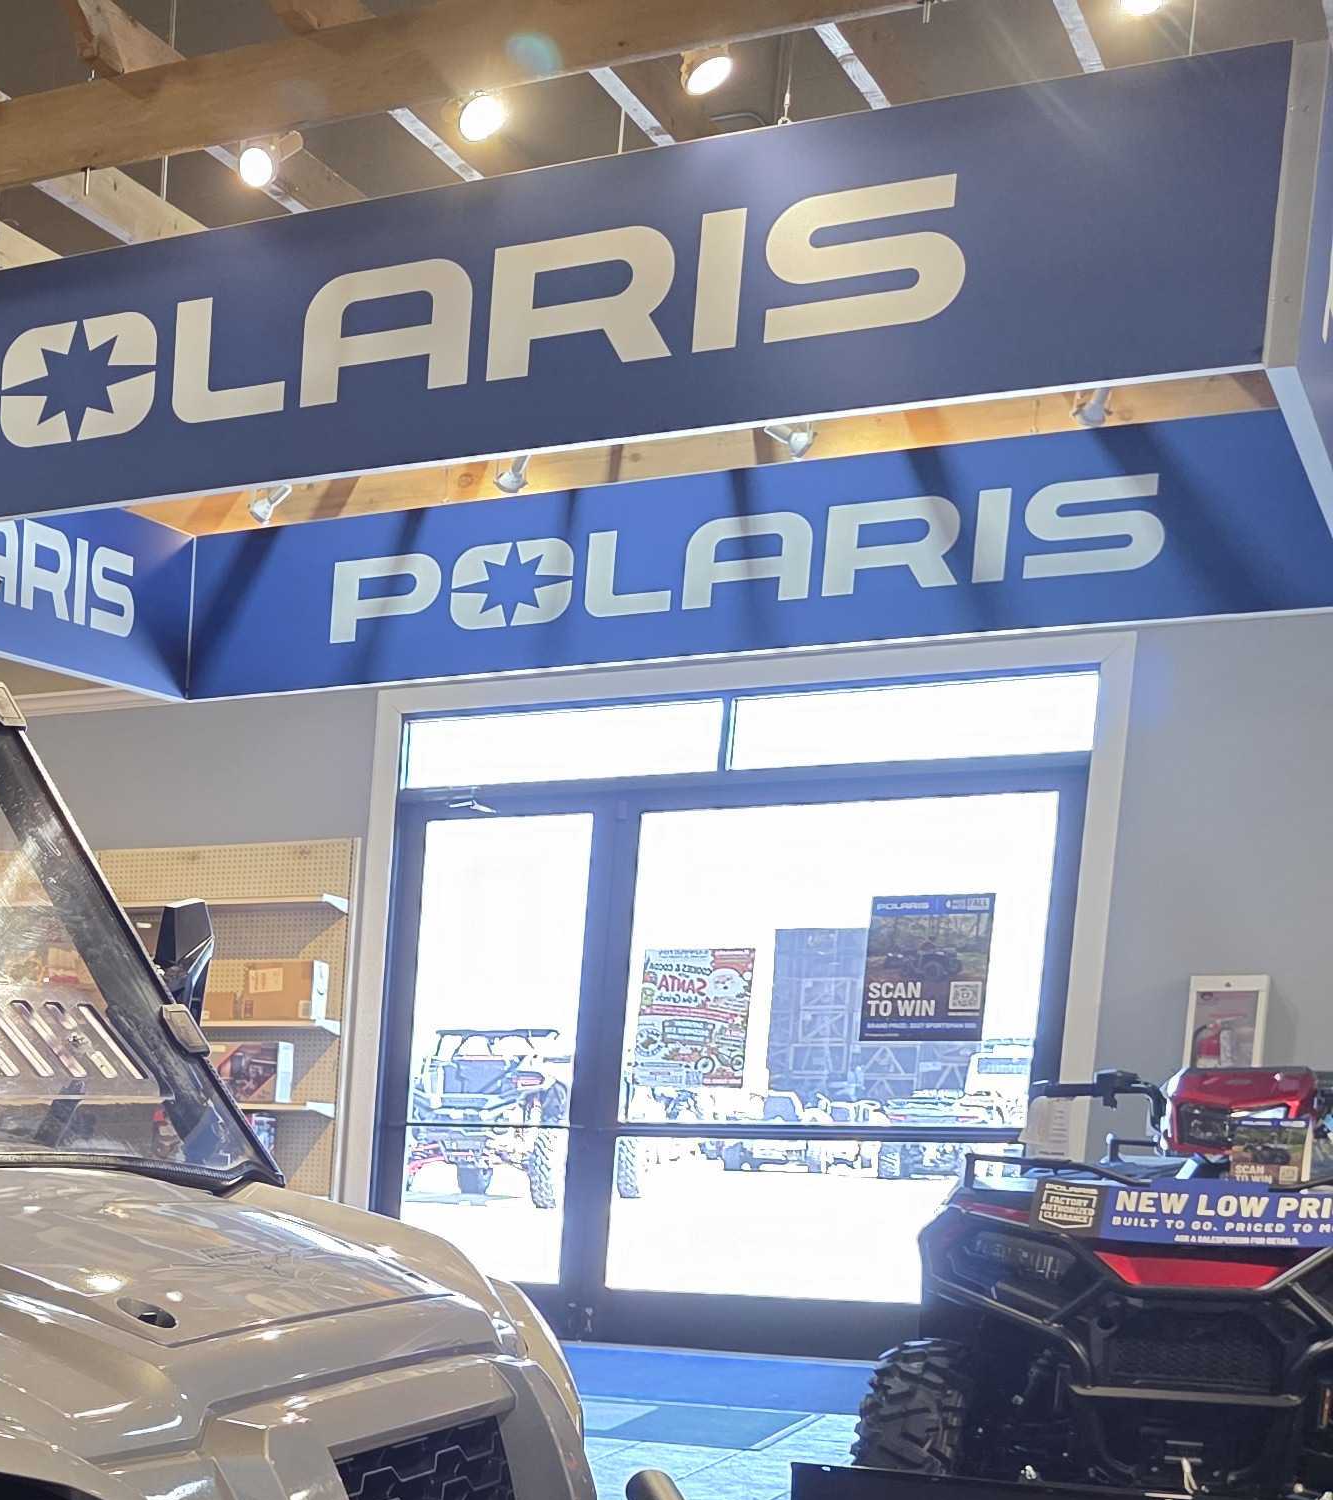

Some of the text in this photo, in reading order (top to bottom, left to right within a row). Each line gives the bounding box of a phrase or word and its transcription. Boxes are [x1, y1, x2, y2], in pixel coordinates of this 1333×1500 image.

[330, 472, 1165, 643] POLARIS
[868, 981, 922, 999] SCAN
[867, 999, 936, 1017] TO WIN
[1115, 1190, 1333, 1219] NEW LOW PRI
[1111, 1215, 1159, 1228] BUILT
[1165, 1219, 1185, 1230] TO
[1191, 1220, 1218, 1231] GO.
[1224, 1221, 1286, 1233] PRICED
[1293, 1223, 1313, 1233] TO
